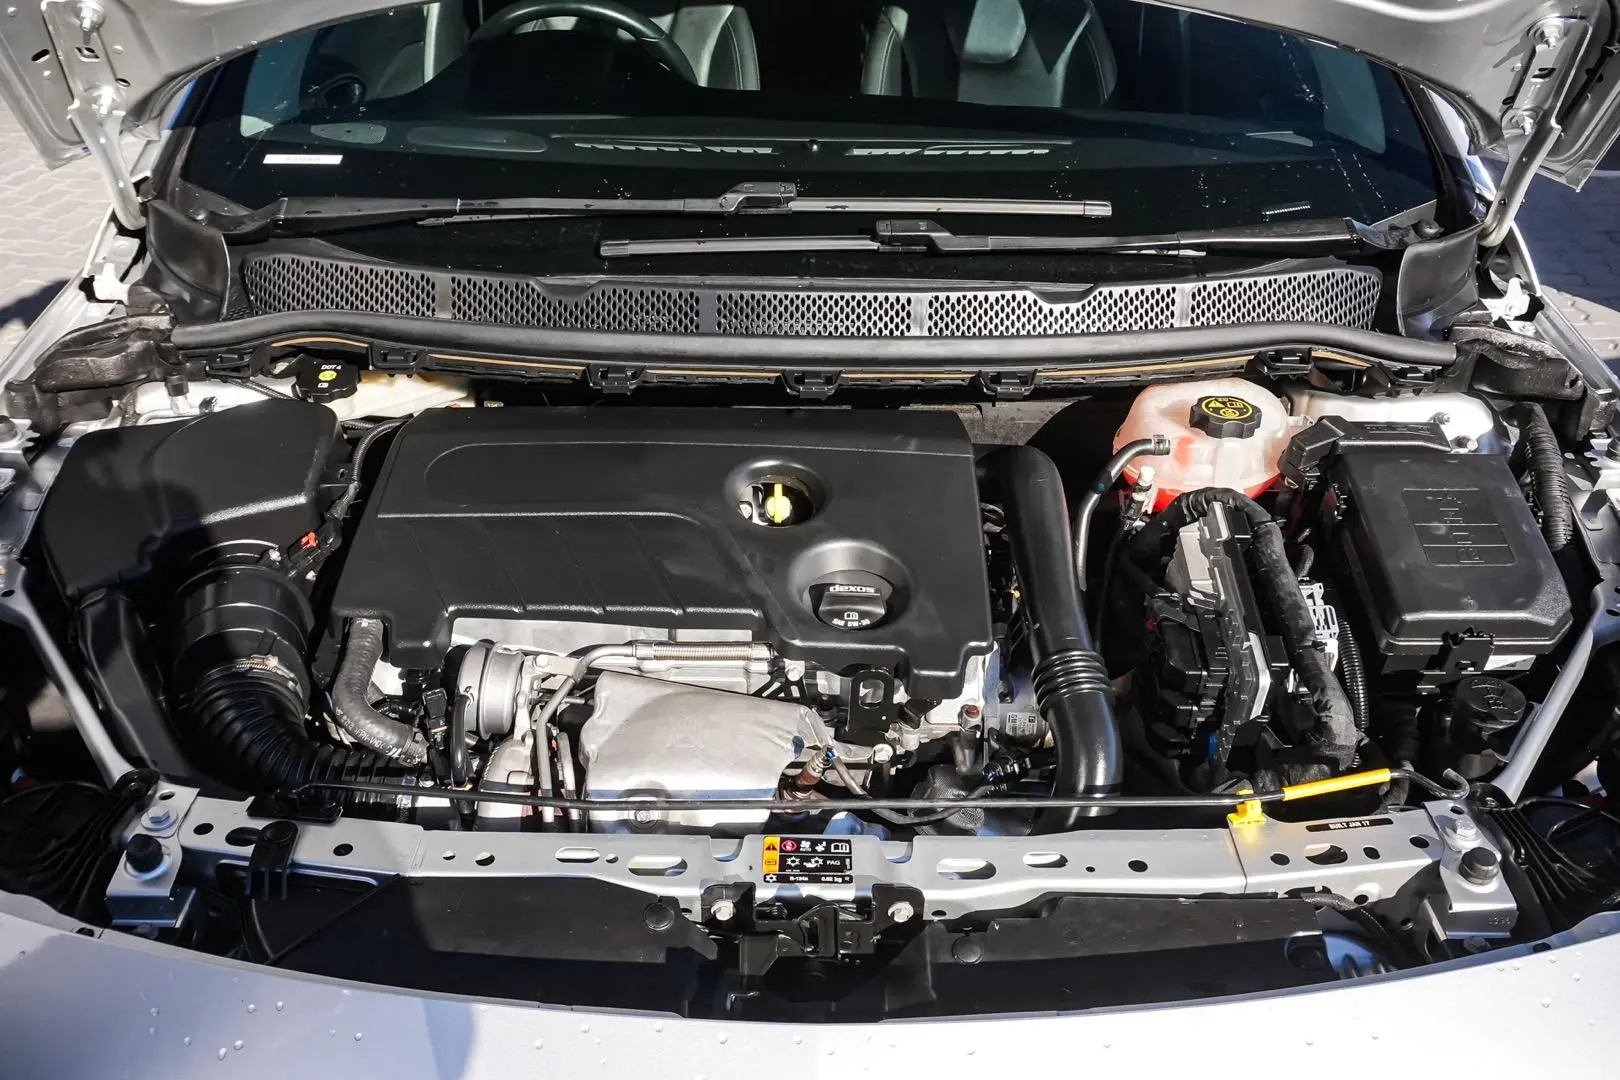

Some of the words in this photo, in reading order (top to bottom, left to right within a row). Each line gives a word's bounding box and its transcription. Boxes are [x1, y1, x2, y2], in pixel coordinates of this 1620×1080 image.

[829, 584, 876, 593] dexos
[1328, 822, 1348, 830] BUILT
[1348, 820, 1362, 828] JAN
